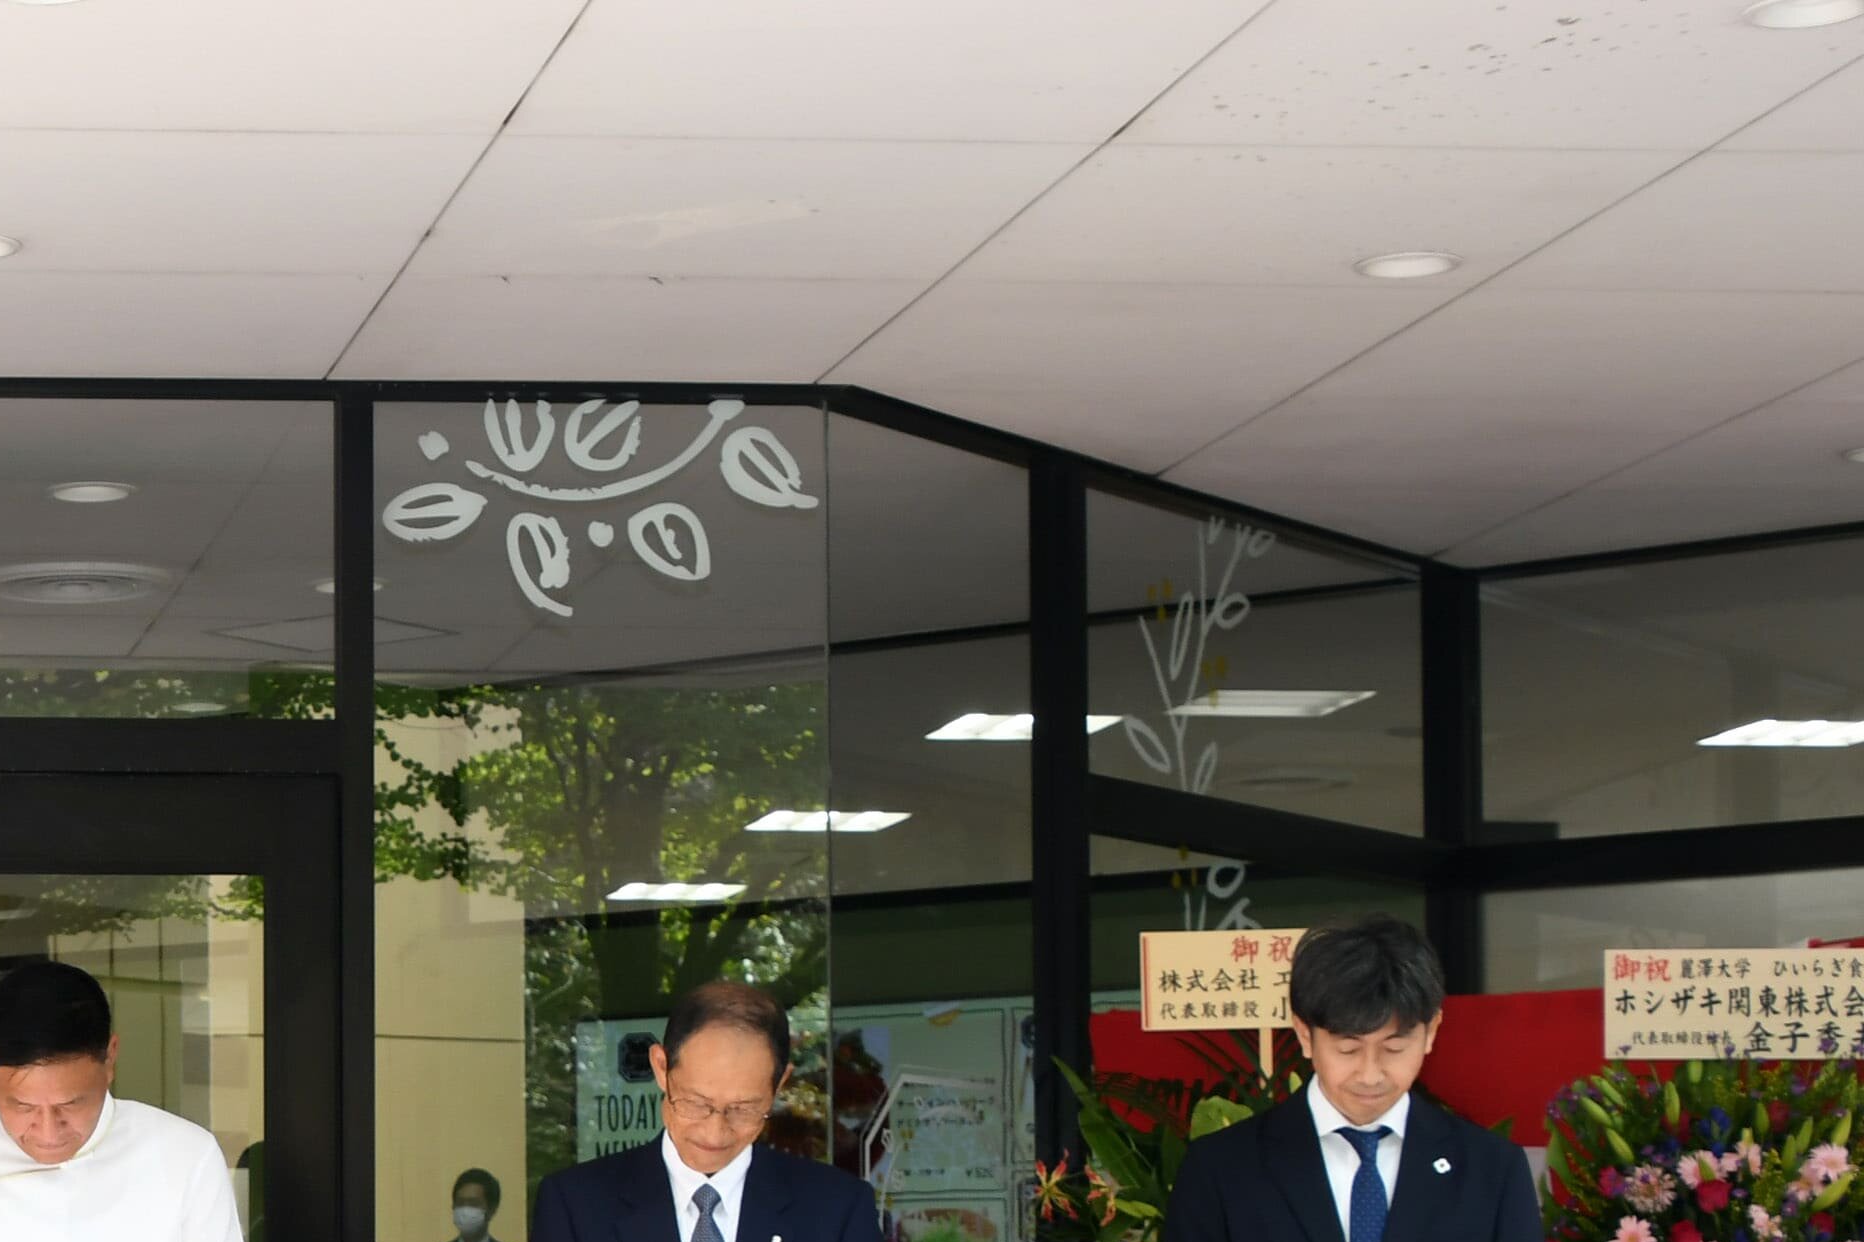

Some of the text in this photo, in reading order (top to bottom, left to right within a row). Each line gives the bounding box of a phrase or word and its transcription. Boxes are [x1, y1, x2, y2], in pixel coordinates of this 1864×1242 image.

[1231, 936, 1293, 965] 御祝
[1158, 967, 1261, 993] 株式会社
[1614, 953, 1672, 982] 御祝
[1160, 1001, 1260, 1020] 代表取締役
